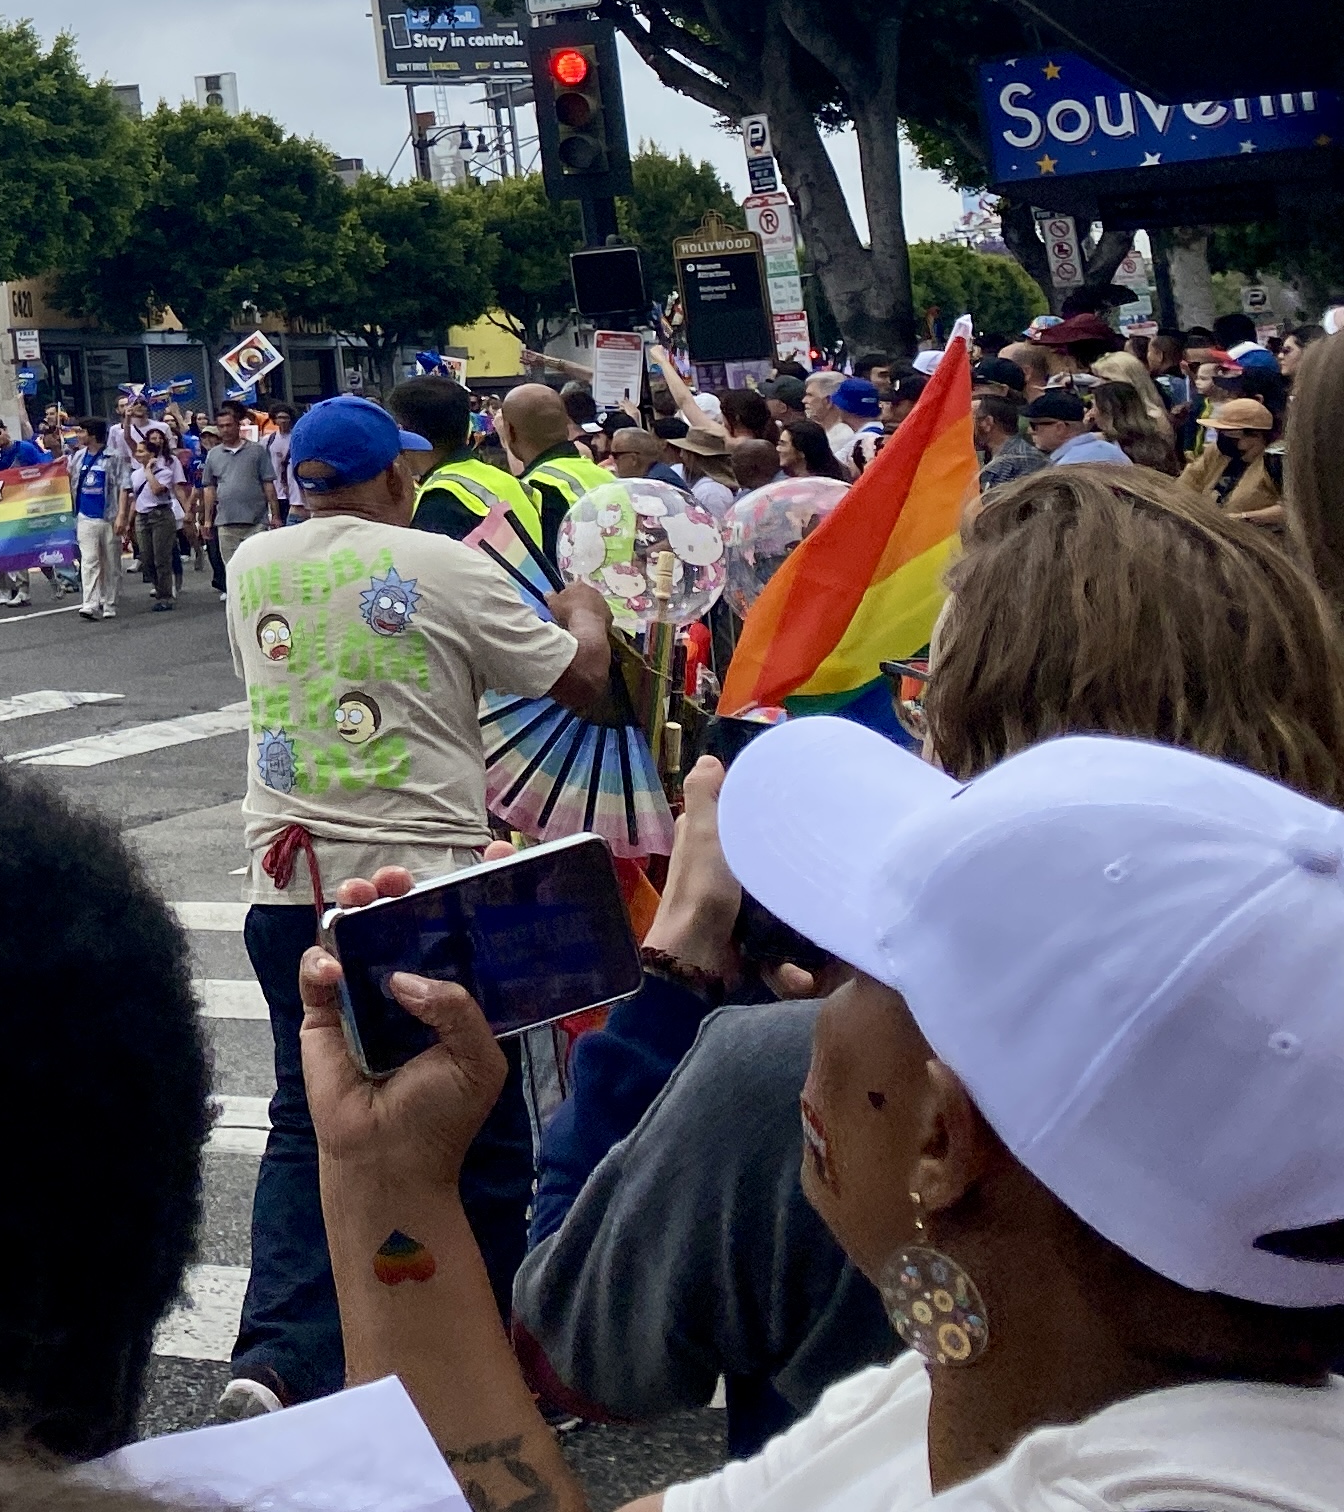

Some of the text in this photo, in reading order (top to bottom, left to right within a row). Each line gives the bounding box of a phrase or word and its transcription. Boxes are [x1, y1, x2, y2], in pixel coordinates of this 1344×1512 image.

[413, 30, 524, 52] Stay in control.
[681, 238, 751, 253] HOLLYWOOD
